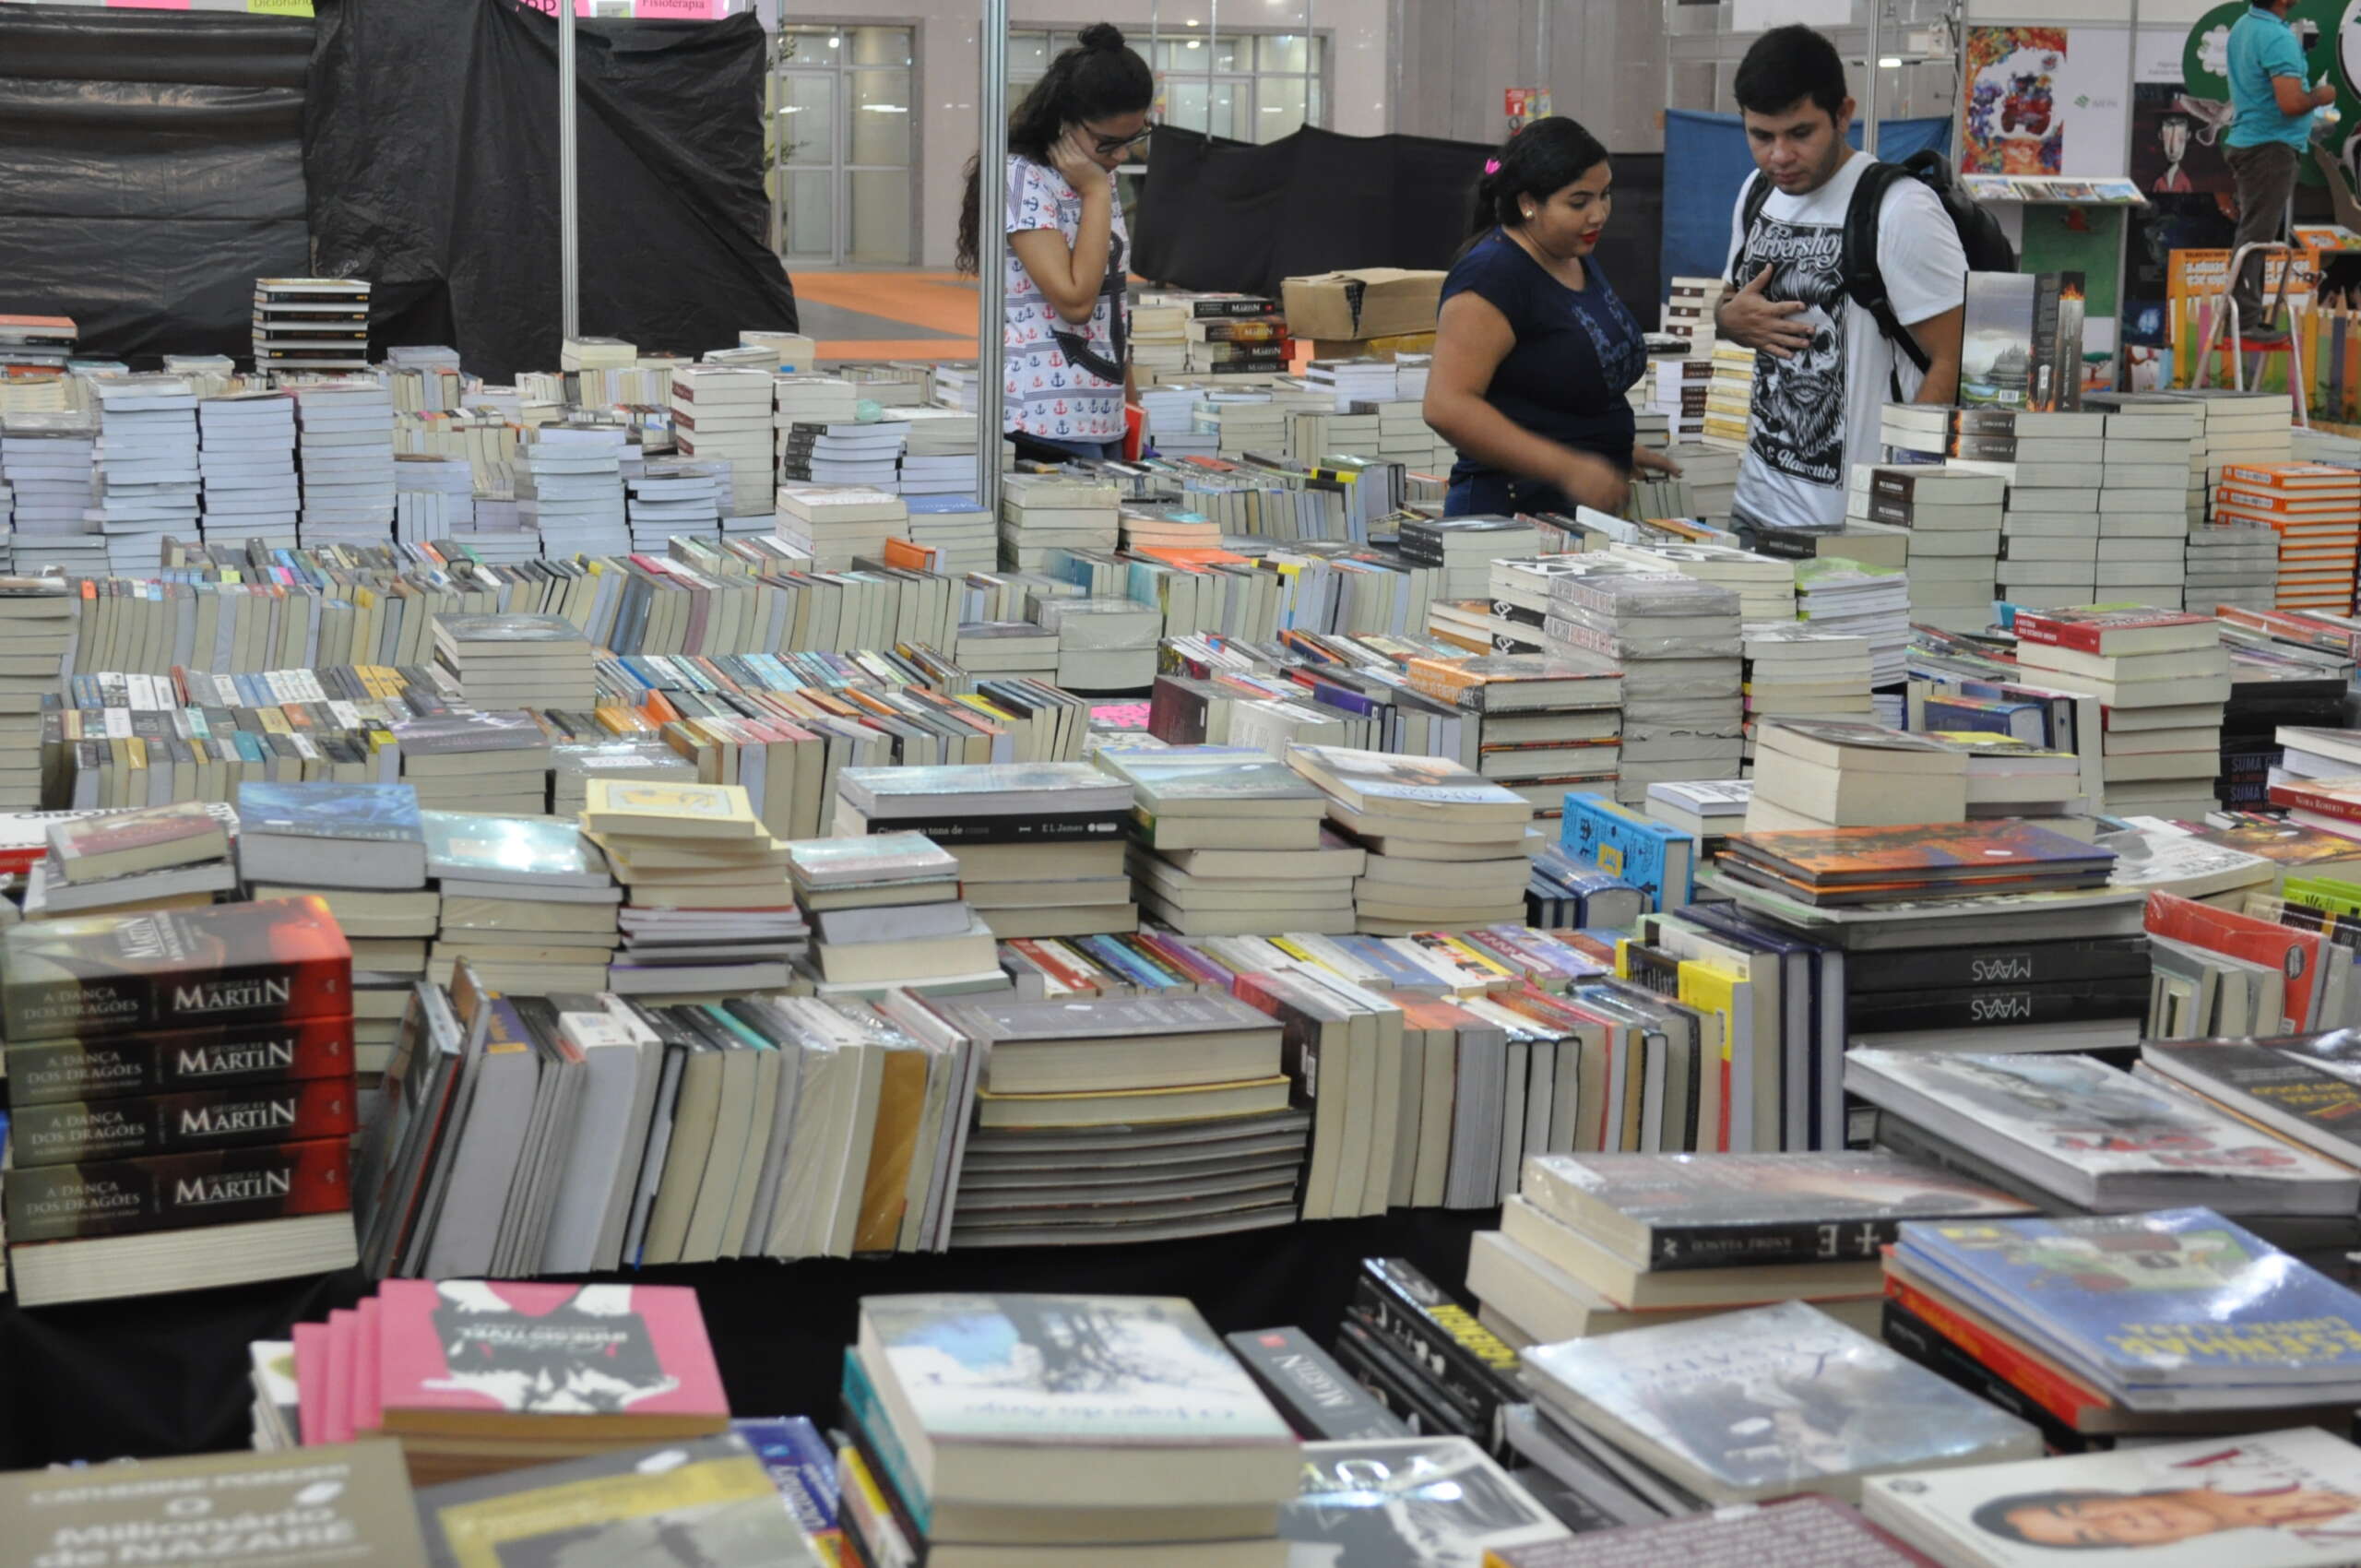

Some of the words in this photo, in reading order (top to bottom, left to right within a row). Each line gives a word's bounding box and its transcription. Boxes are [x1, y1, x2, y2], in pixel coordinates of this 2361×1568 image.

[1972, 958, 2031, 981] MAAS
[59, 987, 117, 1001] DANÇA
[173, 976, 291, 1012] MARTIN
[24, 1004, 61, 1020] DOS
[62, 999, 139, 1016] DRAGÕES
[1971, 997, 2031, 1020] MAAS
[63, 1051, 121, 1066] DANÇA
[176, 1039, 294, 1075] MARTIN
[28, 1070, 62, 1085] DOS
[65, 1063, 142, 1080] DRAGÕES
[66, 1111, 124, 1126] DANÇA
[179, 1099, 296, 1134] MARTIN
[31, 1131, 65, 1146] DOS
[70, 1123, 146, 1141] DRAGÕES
[62, 1181, 119, 1195] DANÇA
[174, 1169, 291, 1205] MARTIN
[26, 1202, 61, 1217] DOS
[65, 1194, 140, 1211] DRAGÕES
